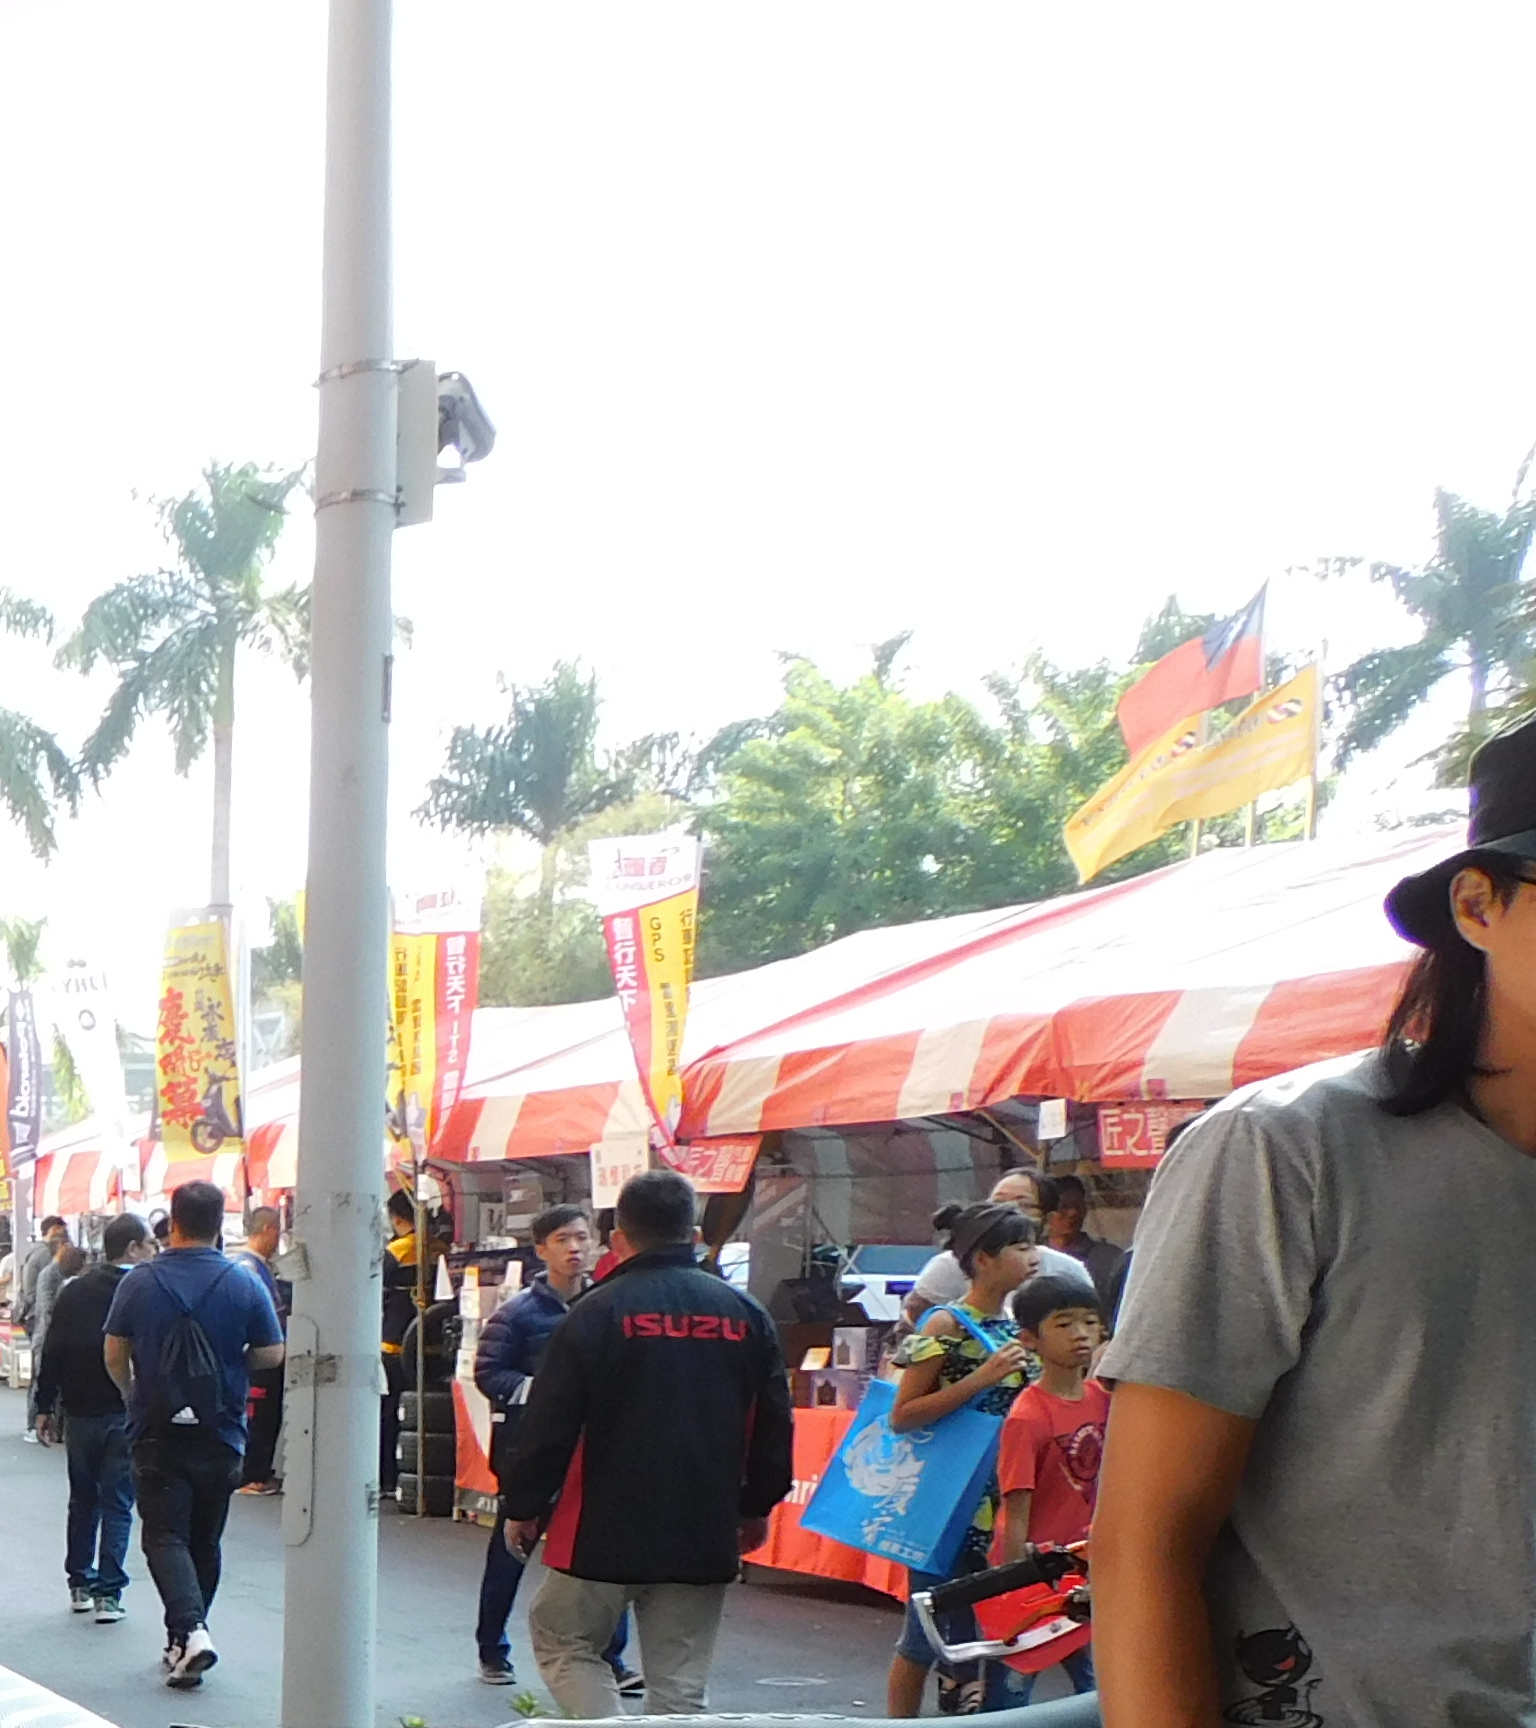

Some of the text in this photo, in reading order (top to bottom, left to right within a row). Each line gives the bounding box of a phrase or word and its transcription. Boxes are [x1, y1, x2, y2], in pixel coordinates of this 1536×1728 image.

[649, 915, 666, 963] GPS
[611, 916, 639, 1014] 智行天下
[622, 1312, 747, 1342] ISUZU
